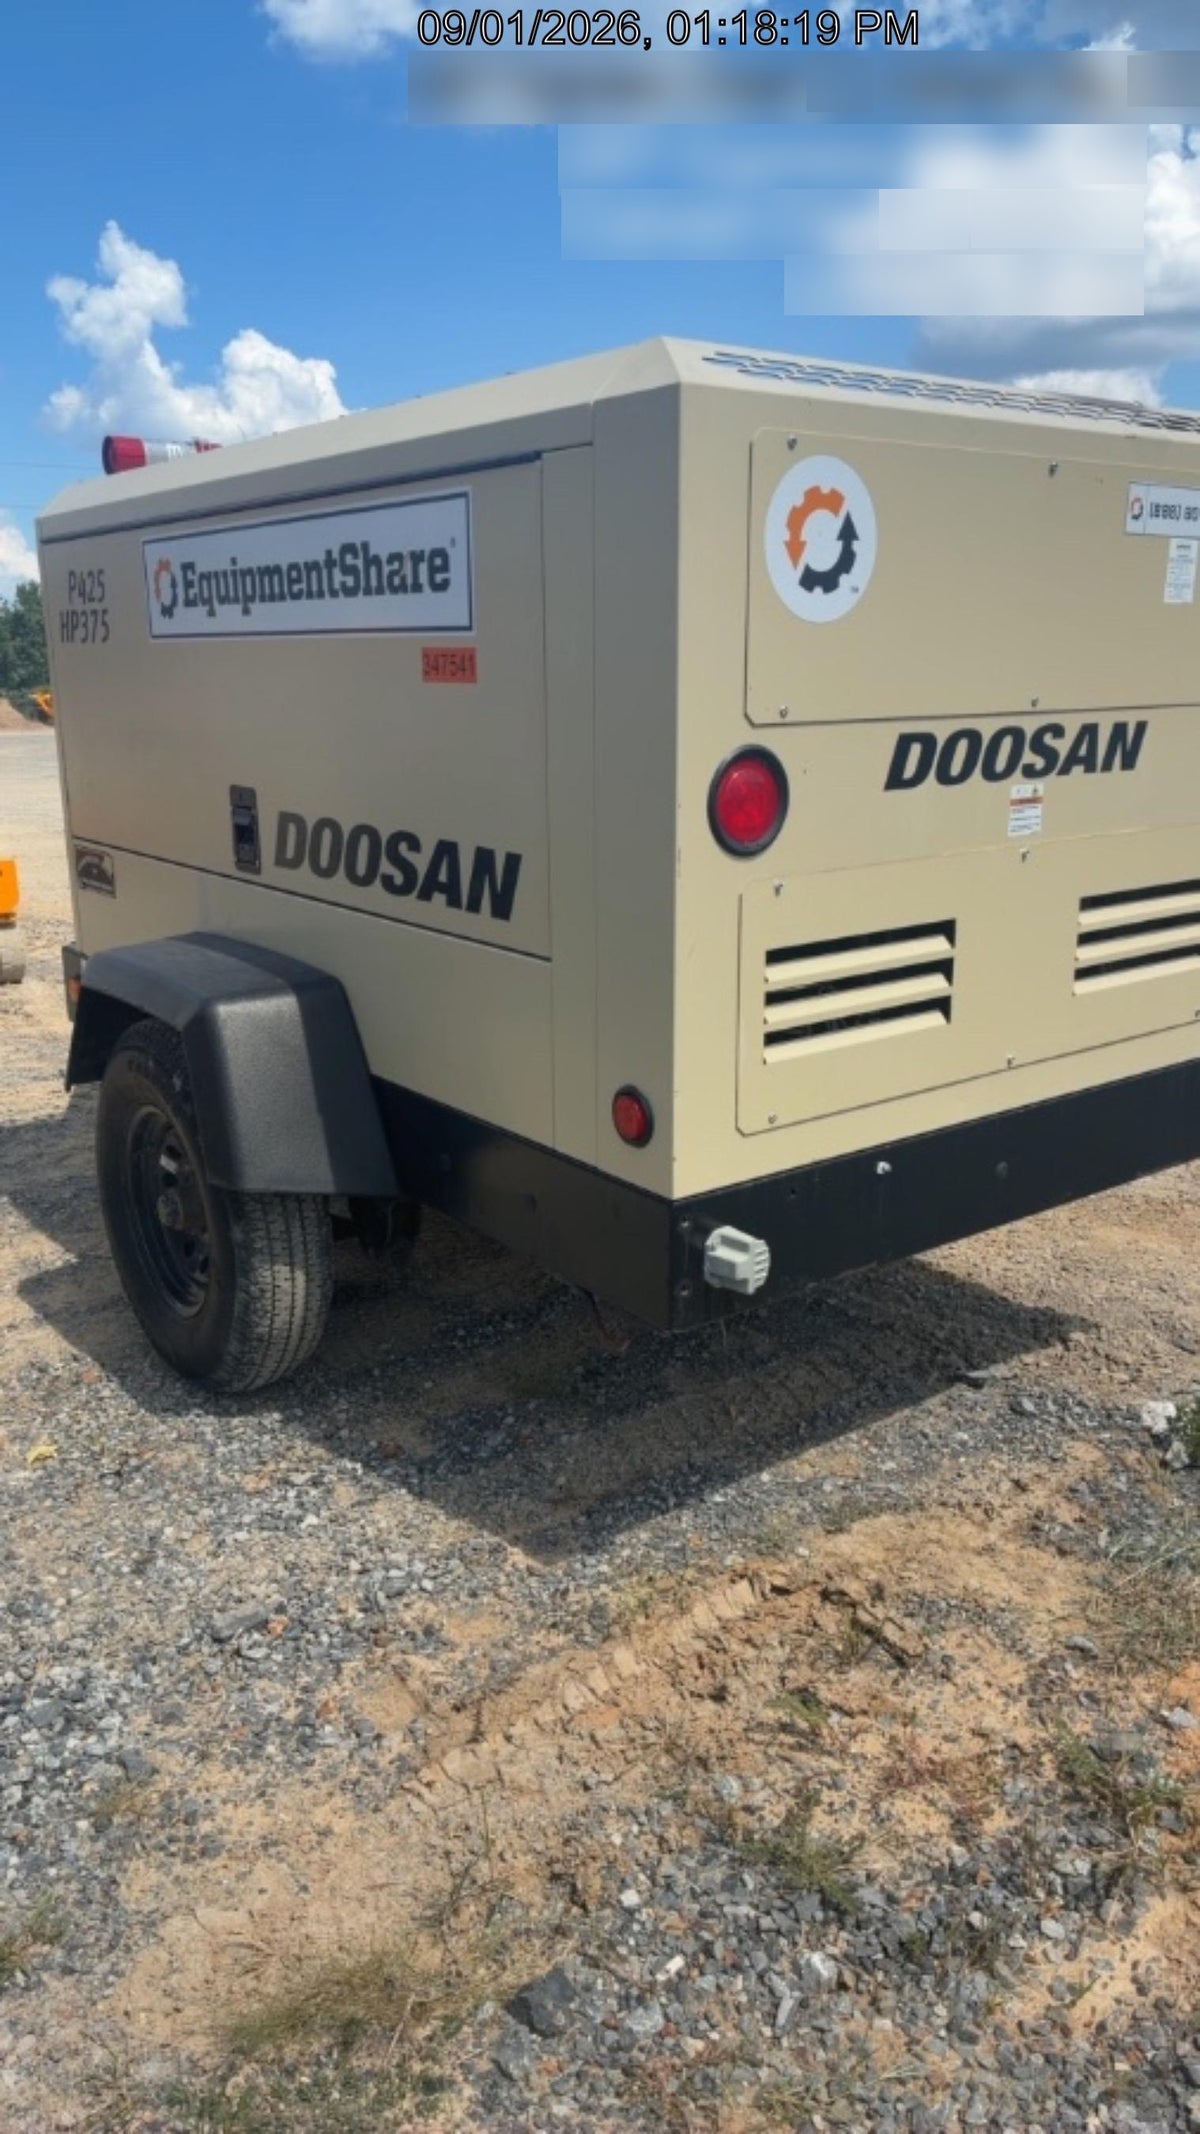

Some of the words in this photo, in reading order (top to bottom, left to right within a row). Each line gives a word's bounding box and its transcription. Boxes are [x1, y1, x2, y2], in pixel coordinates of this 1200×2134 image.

[68, 568, 105, 605] P425
[180, 541, 450, 616] EquipmentShare
[60, 608, 110, 644] HP375
[423, 653, 475, 677] 347541
[884, 720, 1148, 791] DOOSAN
[274, 811, 522, 921] DOOSAN
